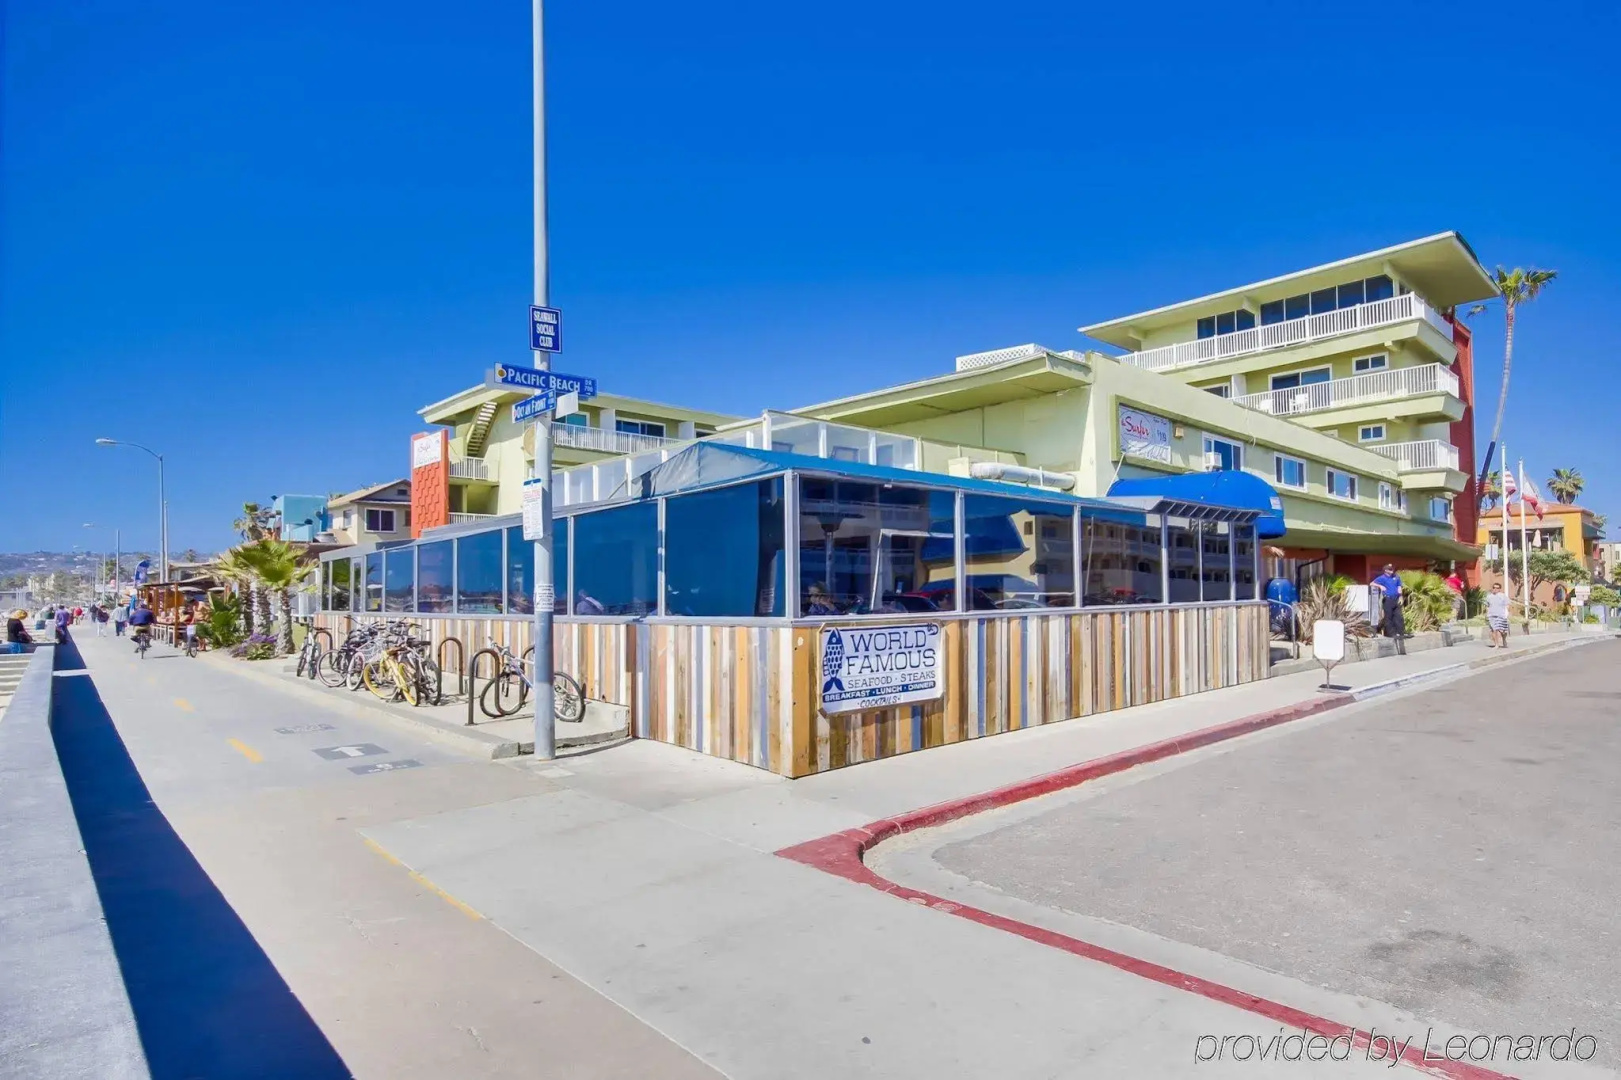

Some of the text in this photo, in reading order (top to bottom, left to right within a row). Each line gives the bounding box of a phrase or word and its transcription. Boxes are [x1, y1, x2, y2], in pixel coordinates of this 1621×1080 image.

[536, 324, 555, 336] SOCIAL
[540, 336, 553, 347] CLUB
[850, 630, 926, 652] WORLD
[846, 648, 936, 675] FAMOUS
[848, 676, 892, 689] SEAFOOD
[825, 681, 934, 701] BREAKFAST LUNCH DINNER
